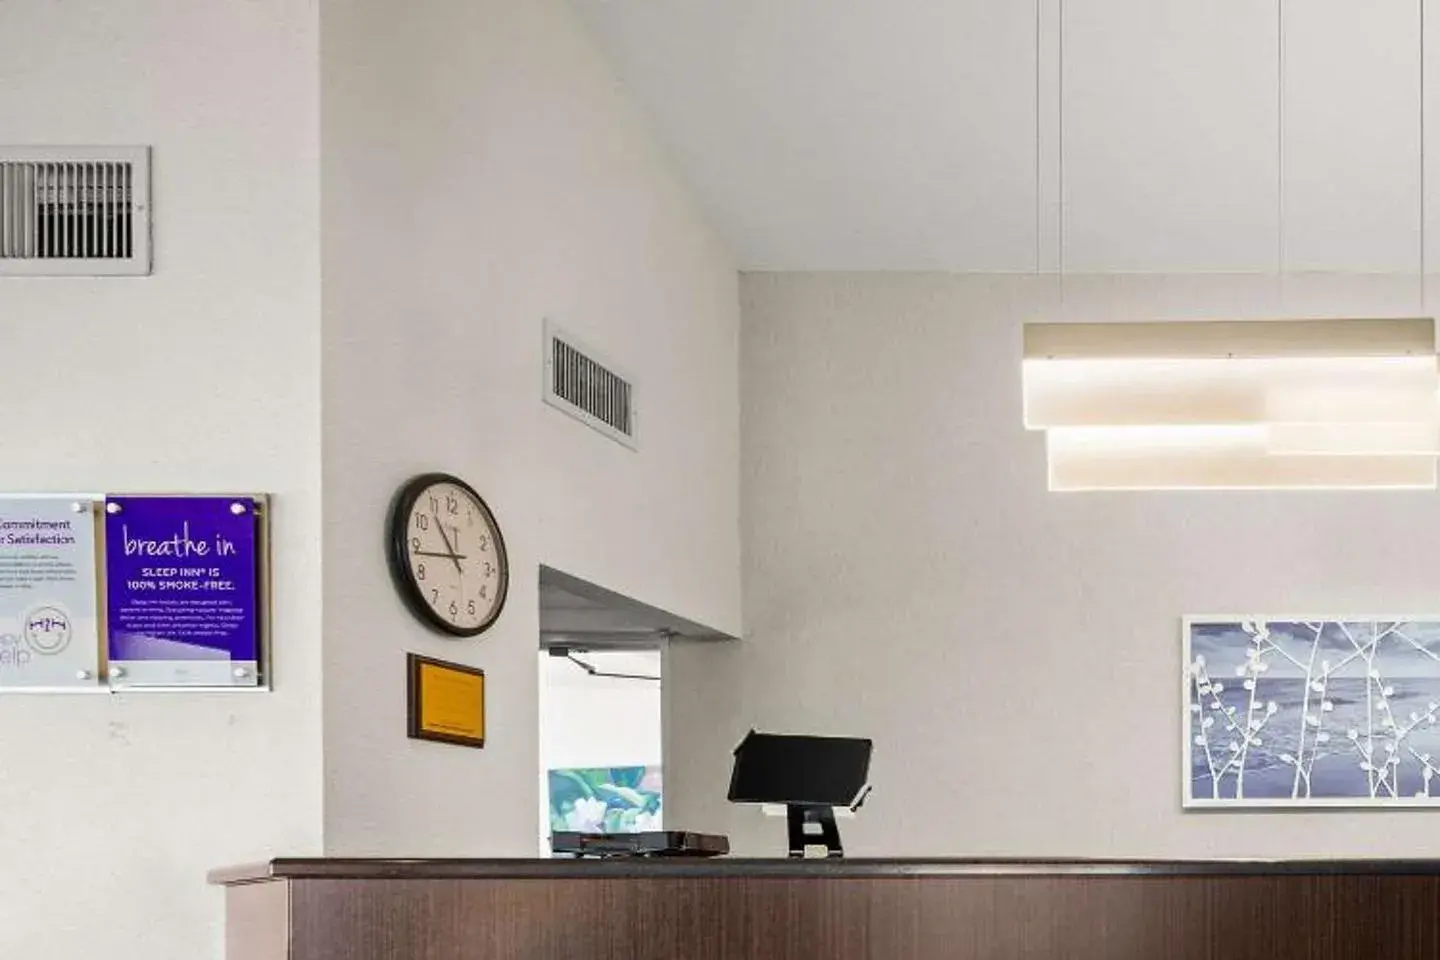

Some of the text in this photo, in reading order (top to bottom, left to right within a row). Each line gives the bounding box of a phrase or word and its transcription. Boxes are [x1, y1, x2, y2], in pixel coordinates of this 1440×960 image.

[429, 495, 439, 515] 11
[446, 495, 458, 515] 12
[415, 511, 428, 531] 10
[7, 533, 76, 545] Satisfaction
[122, 520, 236, 557] breathe in
[412, 537, 421, 556] 9
[480, 534, 487, 552] 2
[141, 567, 178, 577] SLEEP
[208, 567, 220, 577] IS
[418, 563, 425, 580] 8
[484, 562, 491, 578] 3
[127, 581, 235, 590] 100% SMOKE-FREE.
[431, 588, 439, 605] 7
[449, 600, 458, 615] 6
[468, 600, 475, 615] 5
